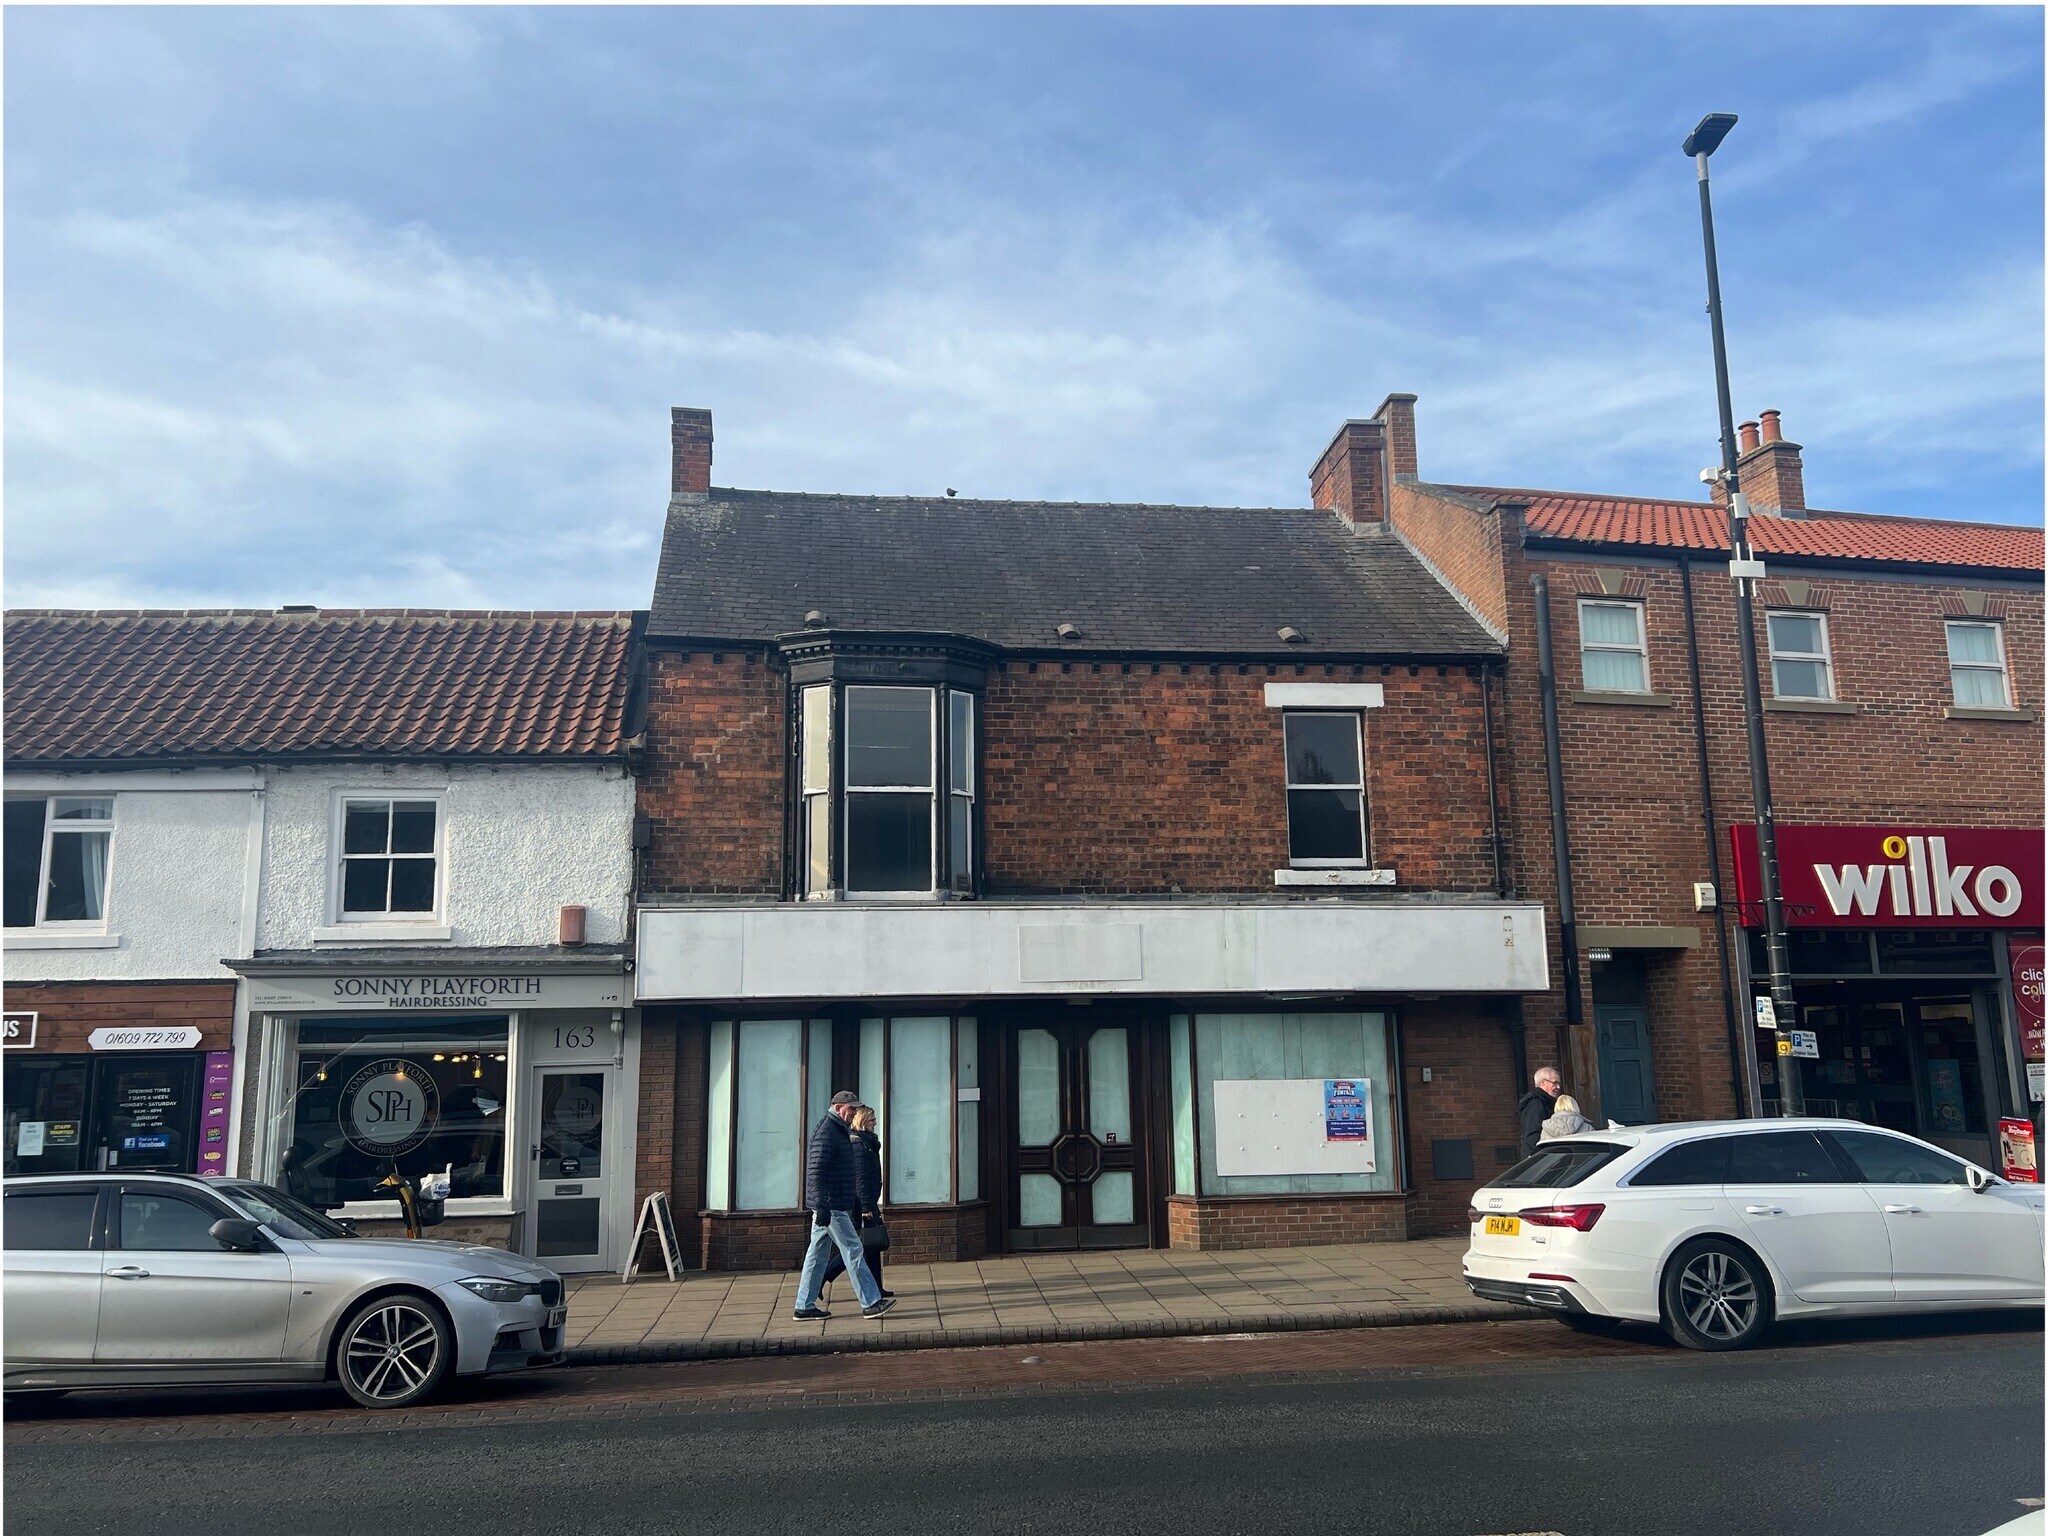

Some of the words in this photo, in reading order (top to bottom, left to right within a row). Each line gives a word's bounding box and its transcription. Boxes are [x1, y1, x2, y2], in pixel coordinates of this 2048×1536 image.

[1813, 835, 2022, 918] wilko
[2022, 968, 2045, 980] clic
[334, 978, 414, 995] SONNY
[421, 978, 540, 995] PLAYFORTH
[390, 996, 487, 1007] HAIRDRESSING
[105, 1033, 140, 1044] 01609
[142, 1032, 164, 1044] 772
[164, 1032, 186, 1044] 799
[553, 1026, 594, 1048] 163
[1794, 1035, 1800, 1046] P
[347, 1065, 378, 1095] SONNY
[382, 1062, 434, 1094] PLAYFORTH
[366, 1090, 413, 1123] SPH
[356, 1139, 416, 1154] HAIRDRESSING
